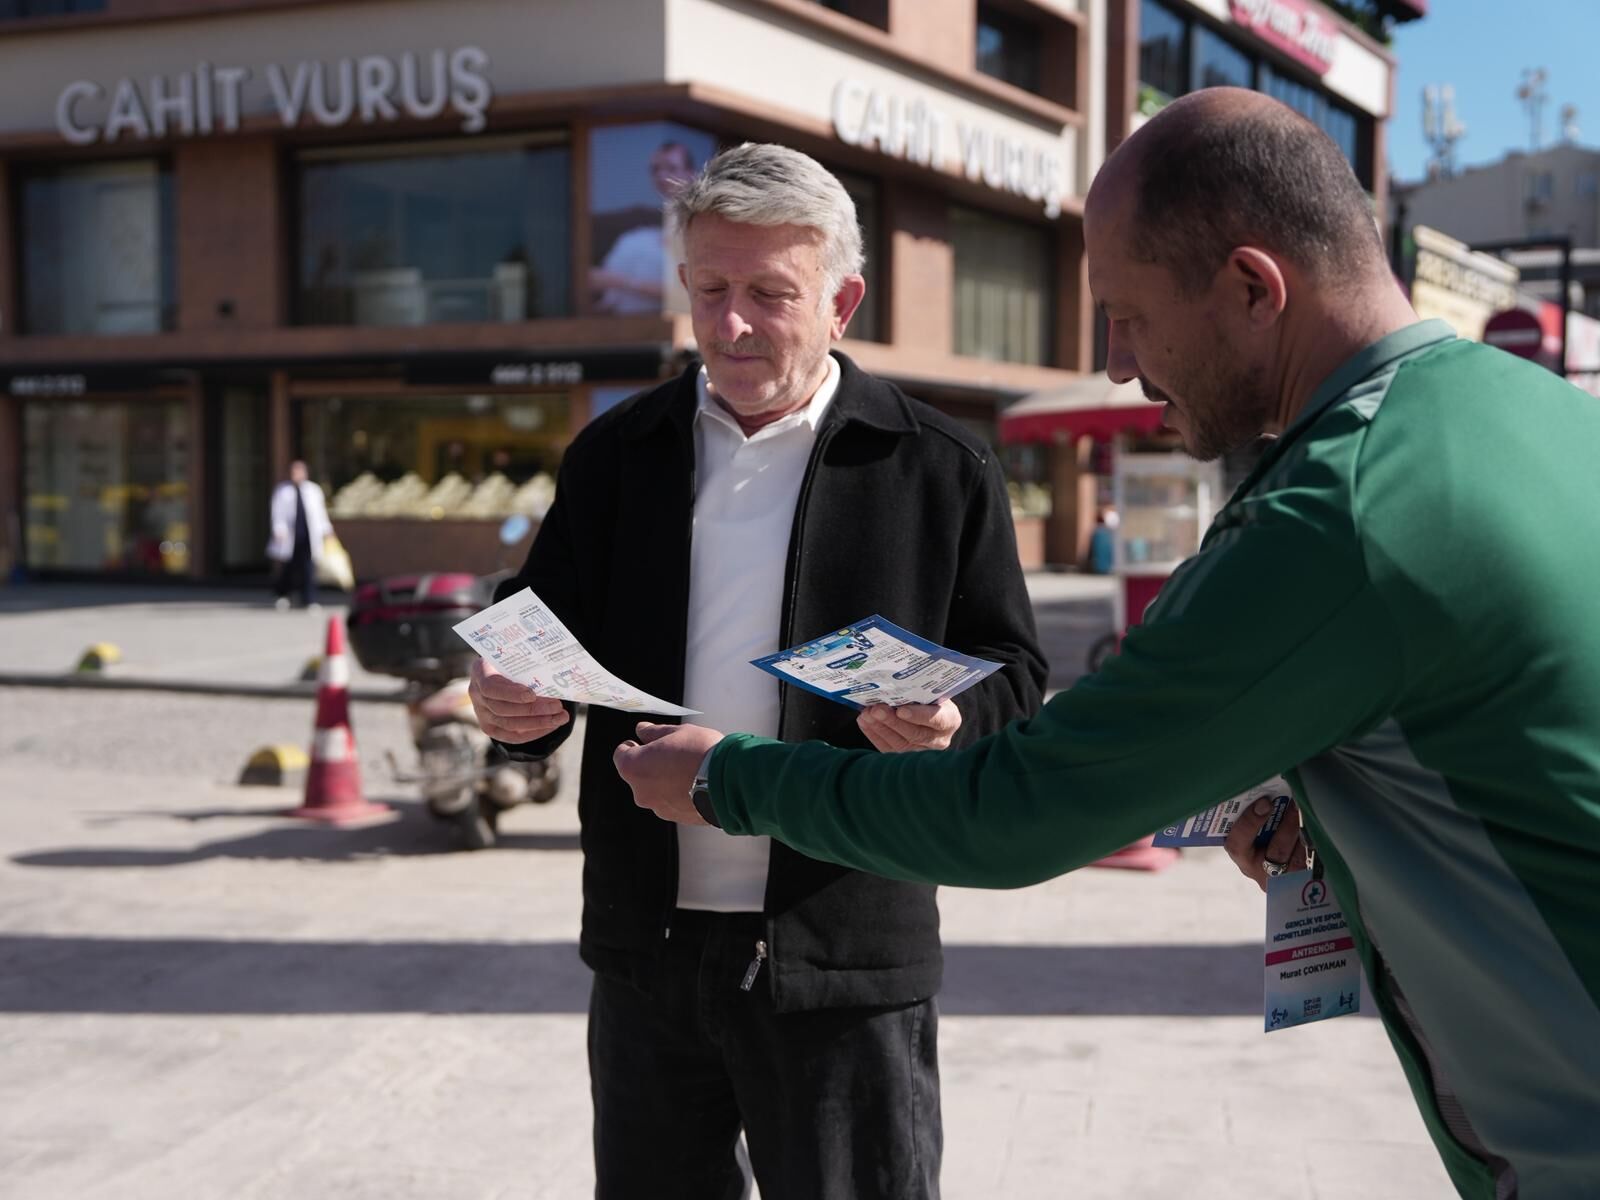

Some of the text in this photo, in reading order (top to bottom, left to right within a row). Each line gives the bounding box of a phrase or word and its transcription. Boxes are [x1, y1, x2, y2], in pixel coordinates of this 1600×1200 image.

[55, 46, 491, 146] CAHİT VURUŞ
[831, 79, 948, 172] CAHİT
[1285, 912, 1342, 930] GENÇLİK VE SPOR
[1273, 928, 1311, 942] HİZMETLERİ
[1292, 943, 1336, 958] ANTRENÖR
[1280, 959, 1347, 980] Murat ÇOKYAMAN
